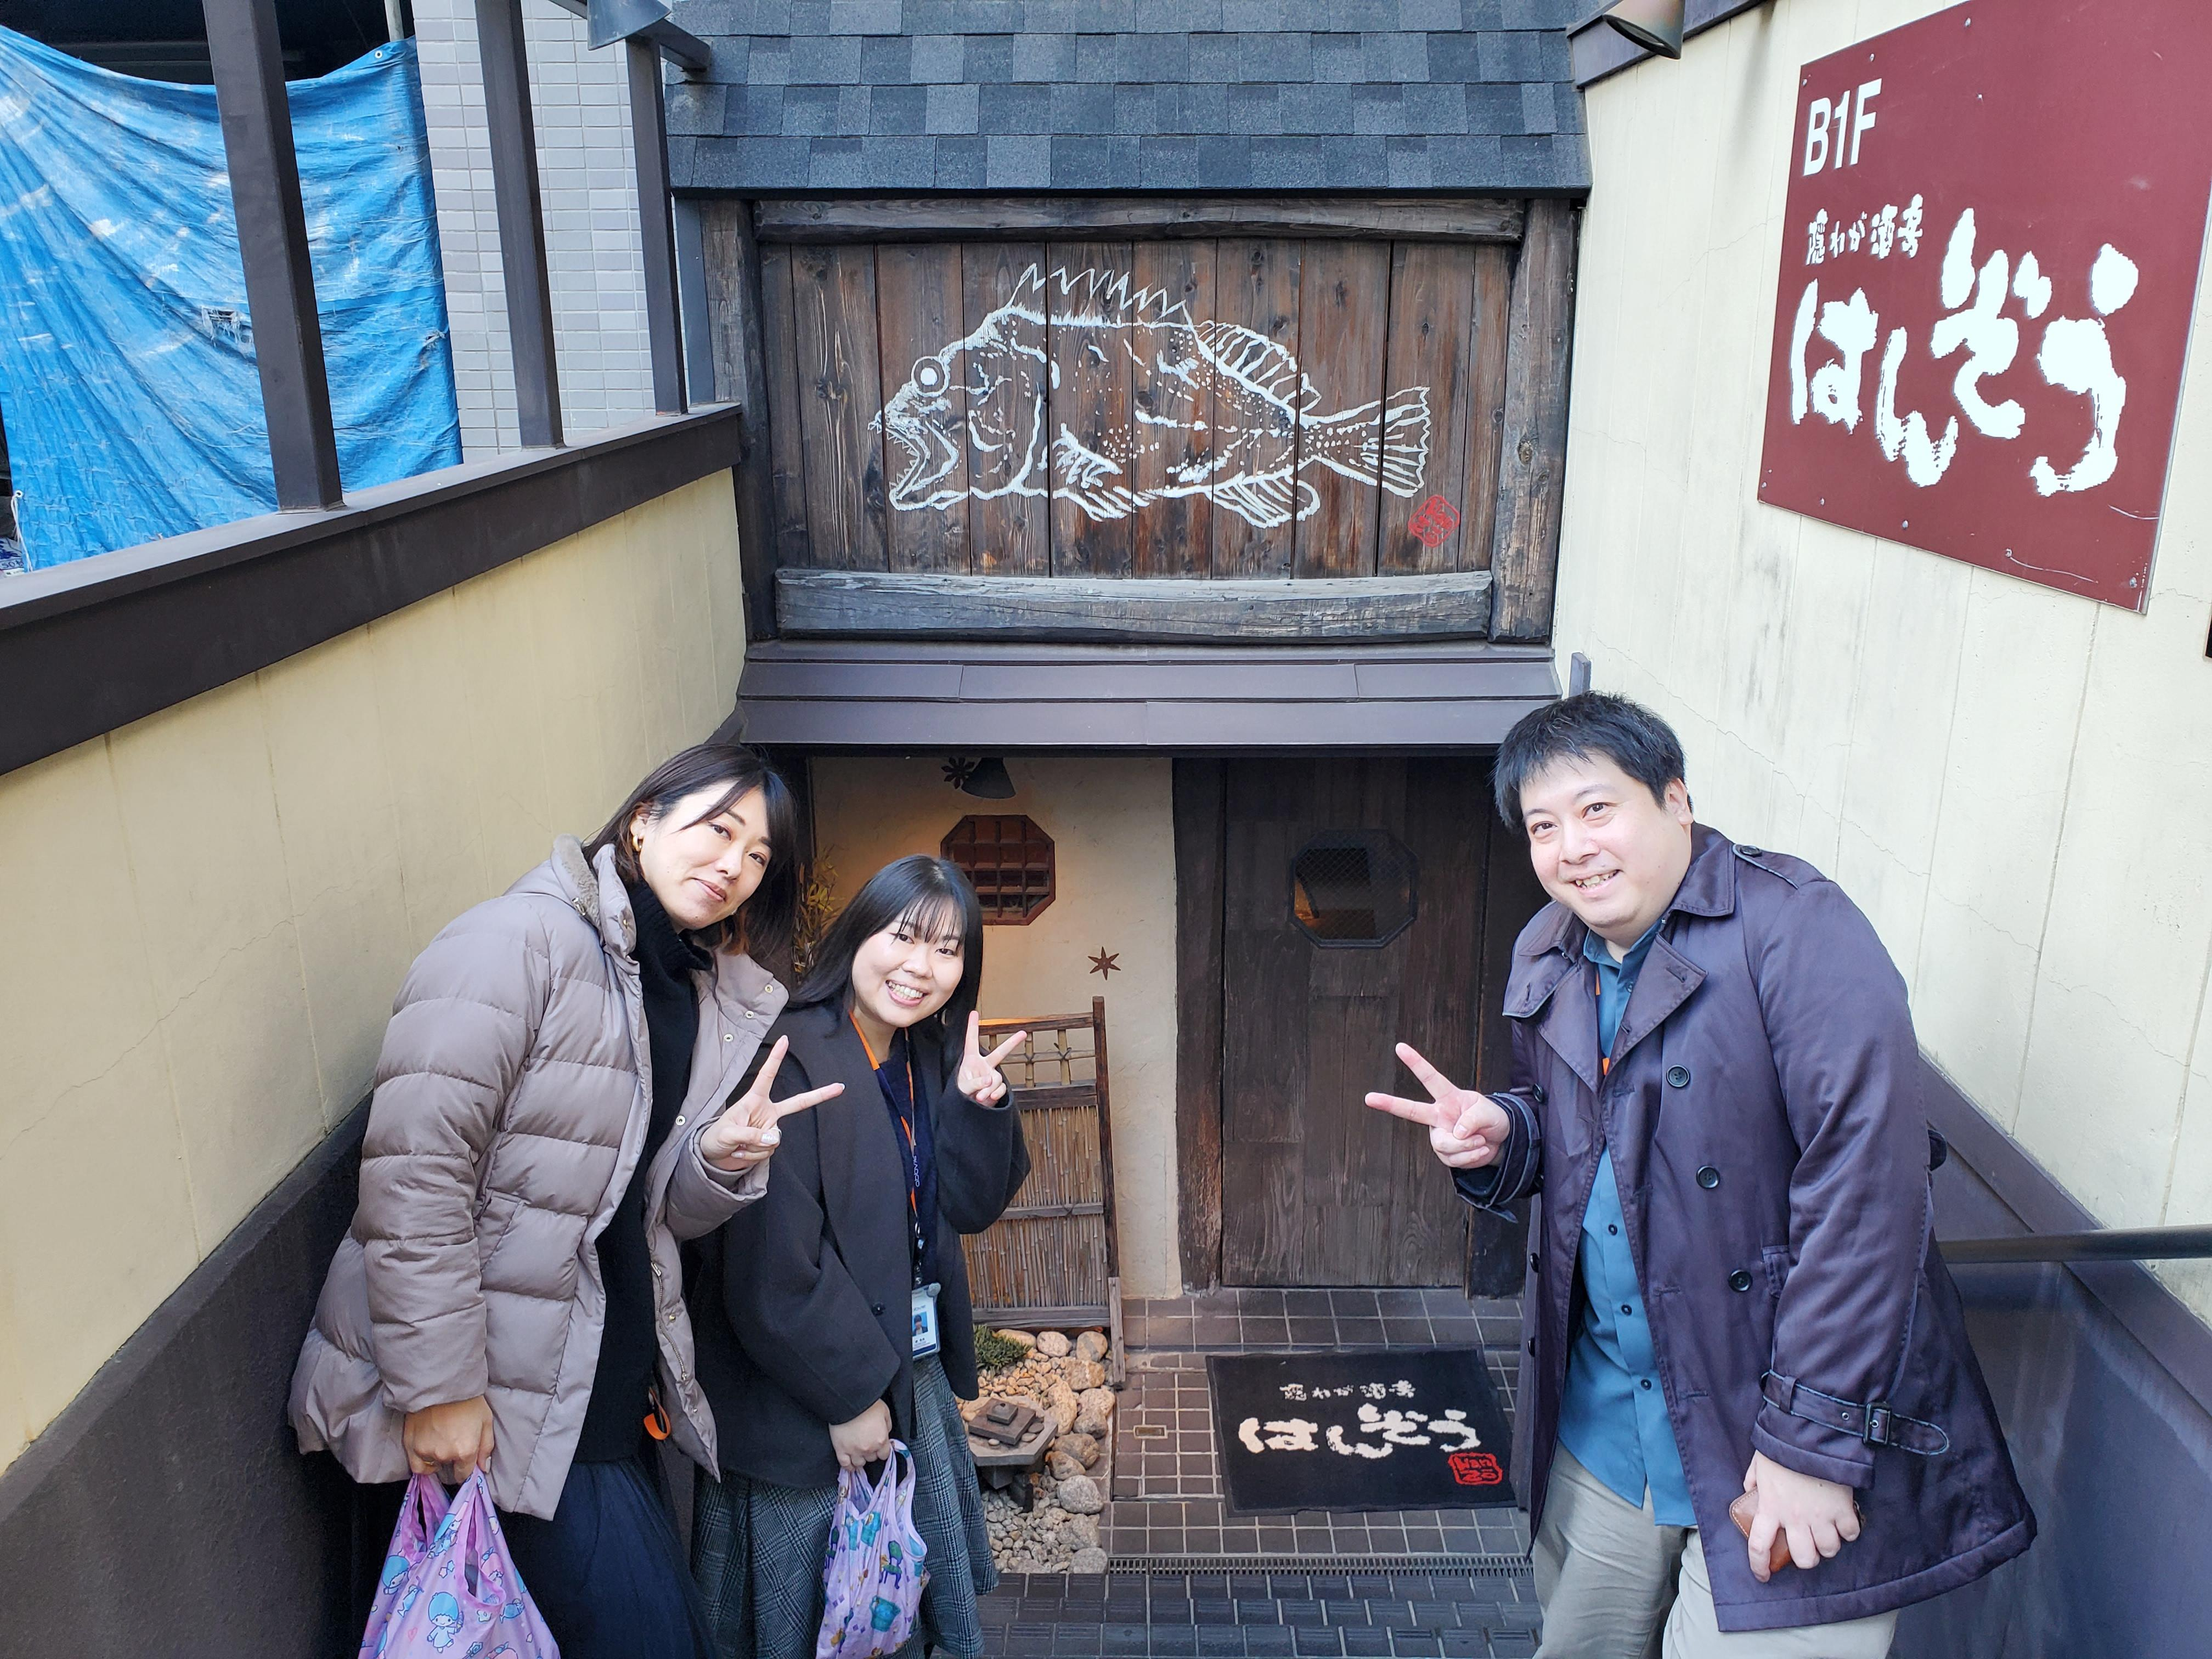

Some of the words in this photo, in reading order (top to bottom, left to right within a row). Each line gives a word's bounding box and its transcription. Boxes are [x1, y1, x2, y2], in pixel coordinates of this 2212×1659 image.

[1803, 78, 1882, 176] B1F
[1790, 207, 2139, 497] はんぞう
[1238, 1402, 1482, 1459] はんぞう
